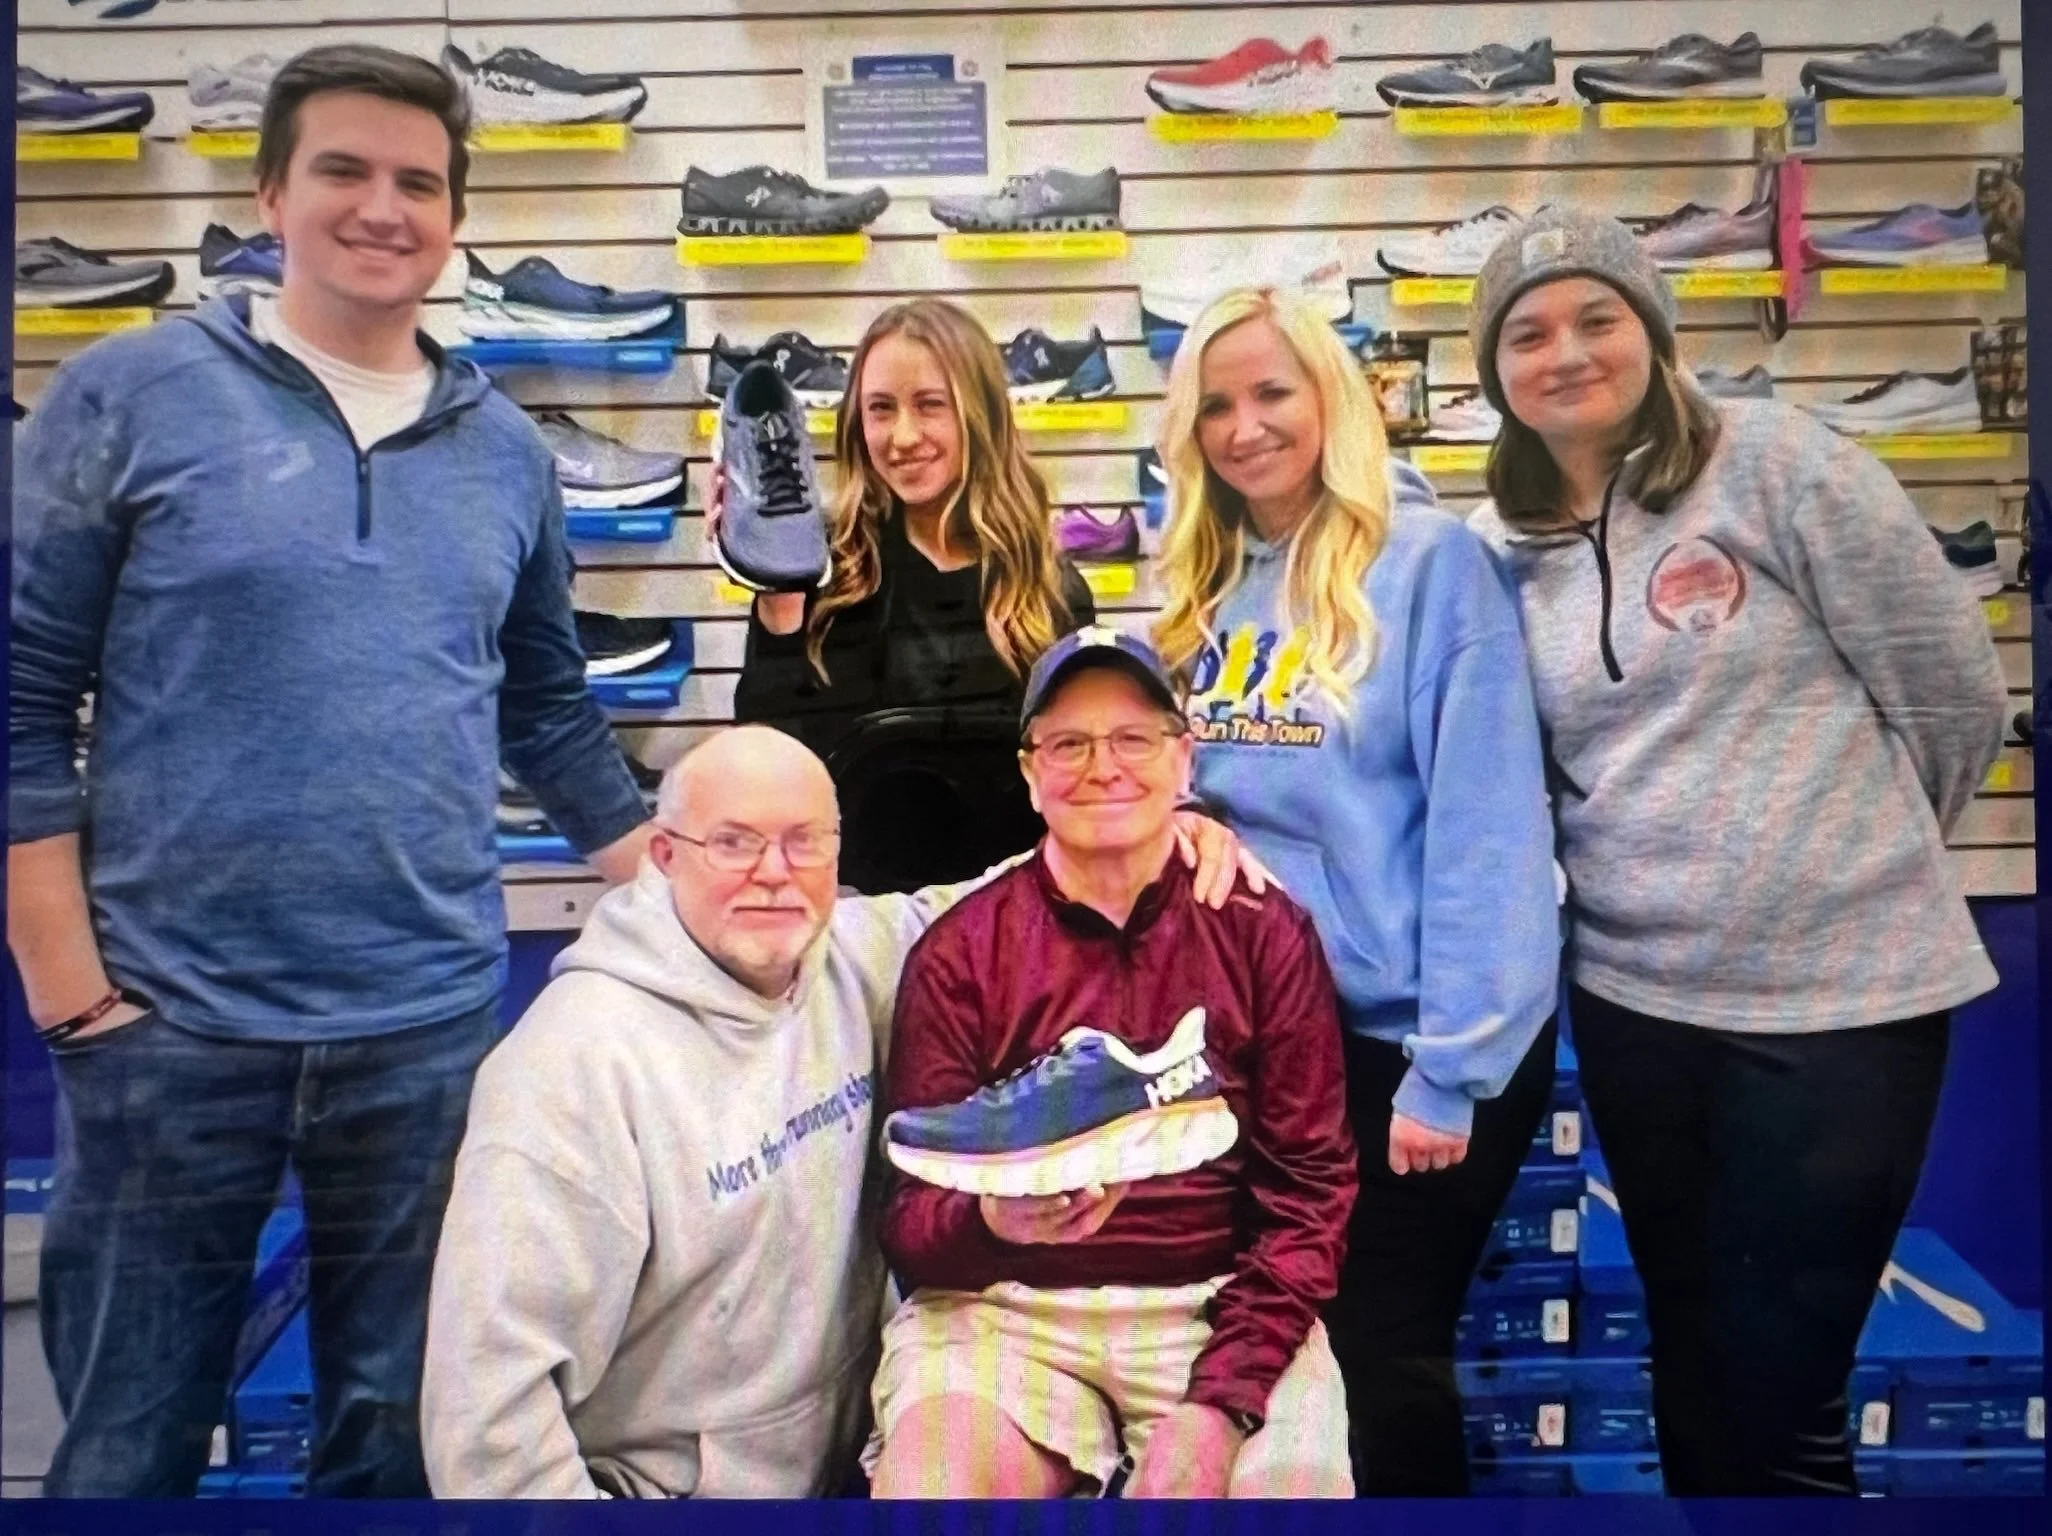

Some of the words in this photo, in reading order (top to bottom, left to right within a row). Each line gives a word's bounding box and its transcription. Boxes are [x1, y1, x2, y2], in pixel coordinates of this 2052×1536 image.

[1270, 716, 1323, 747] Town
[1143, 1054, 1212, 1109] HOKA
[706, 1155, 758, 1202] More
